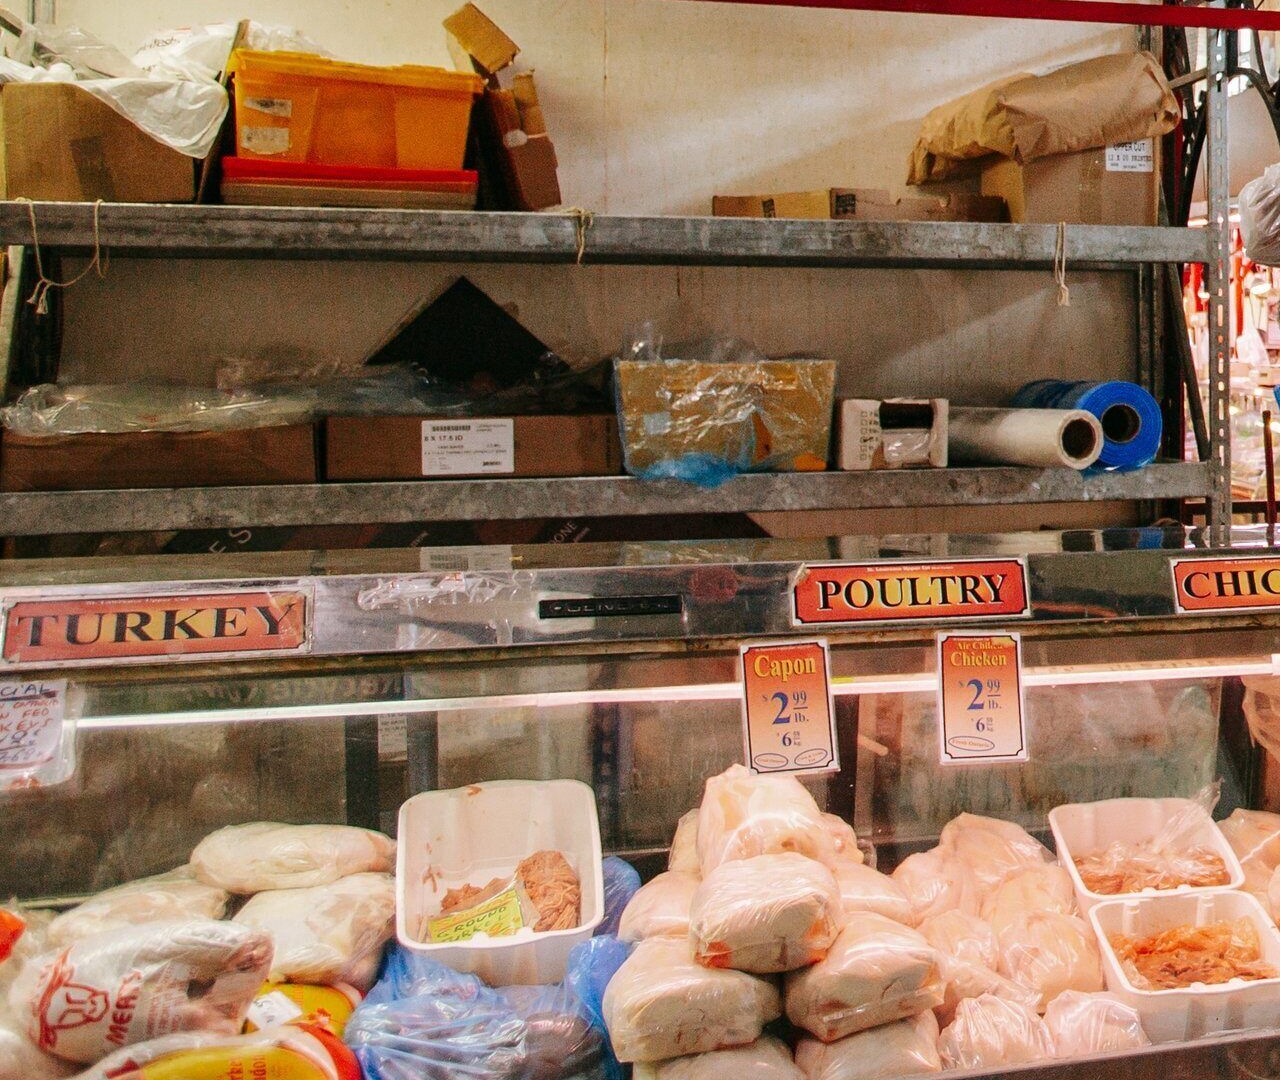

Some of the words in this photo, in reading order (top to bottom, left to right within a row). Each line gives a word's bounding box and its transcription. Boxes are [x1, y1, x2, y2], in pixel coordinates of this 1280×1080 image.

[817, 573, 1007, 611] POULTRY
[17, 603, 296, 647] TURKEY
[753, 654, 816, 681] Capon
[950, 651, 1007, 667] Chicken
[986, 680, 1001, 691] 99
